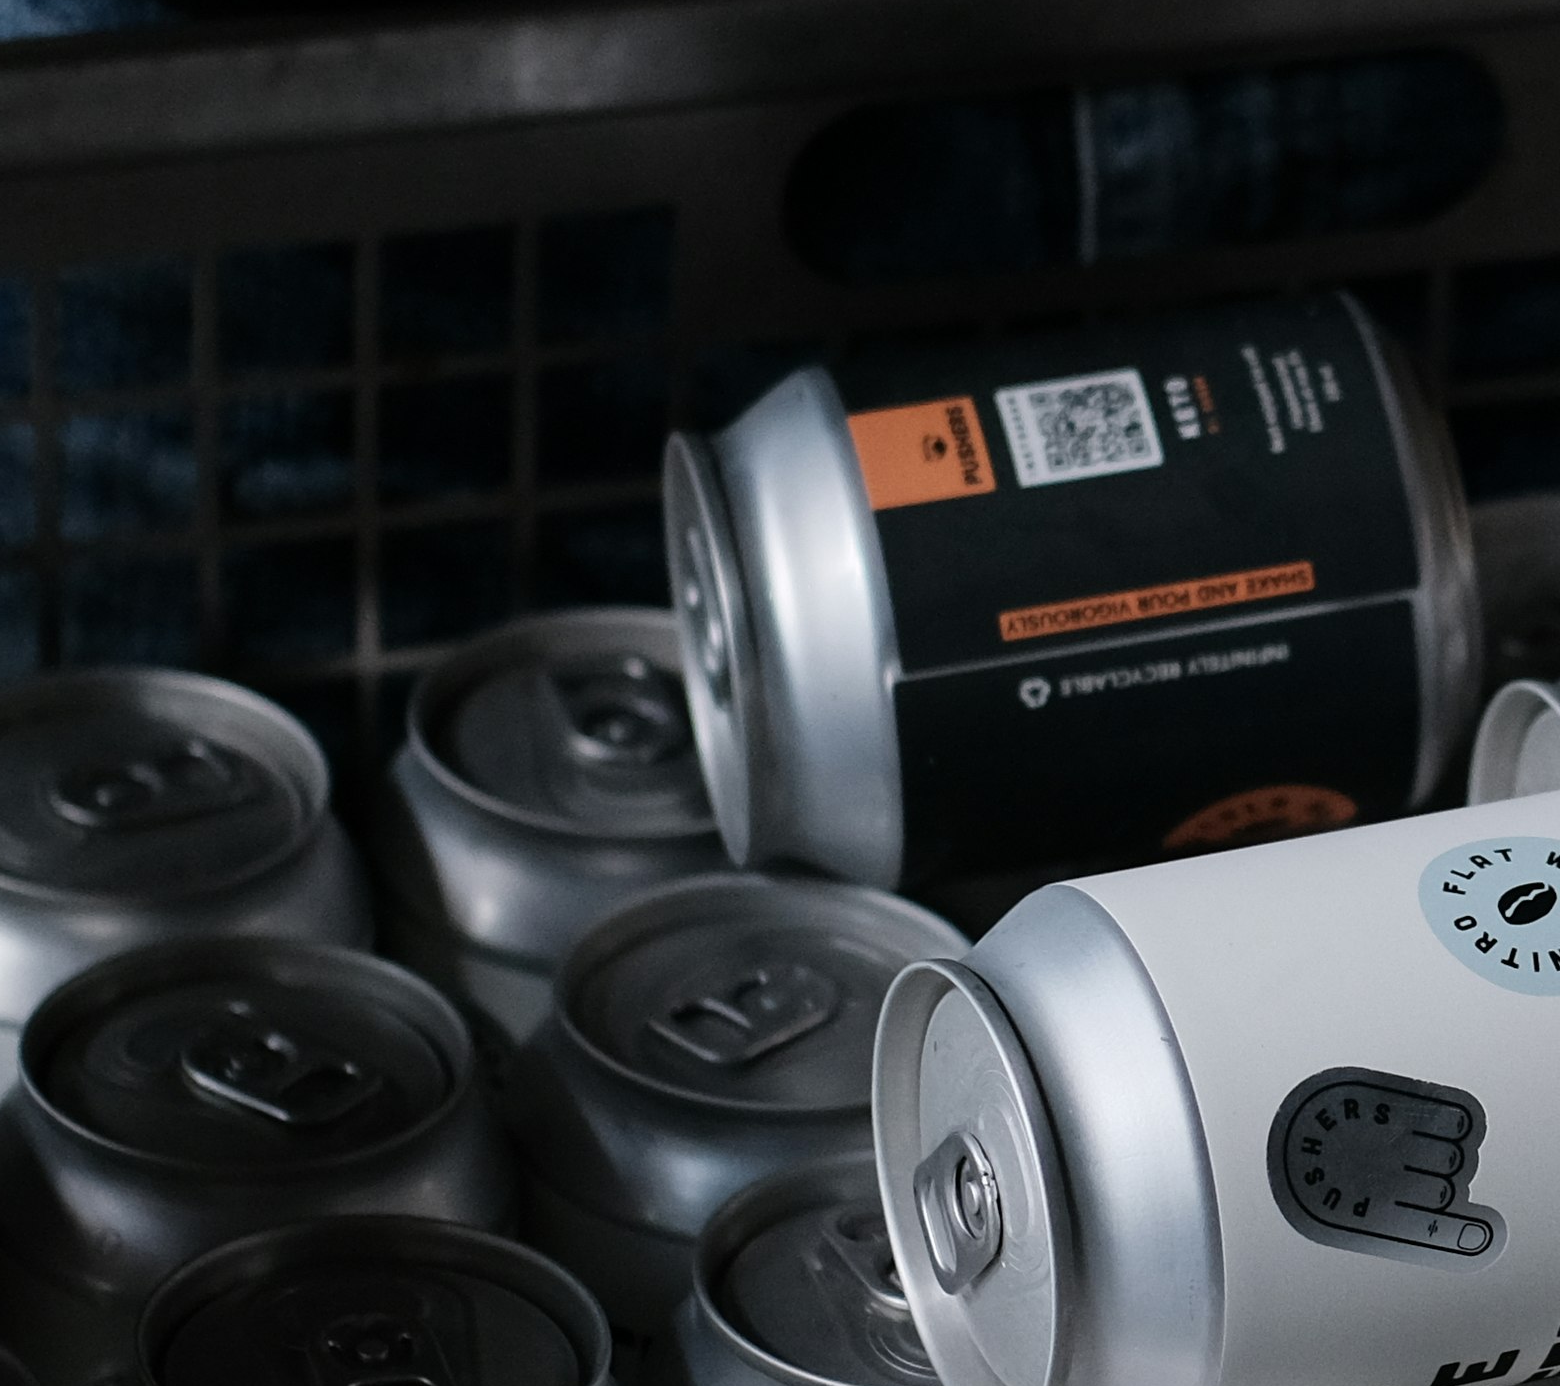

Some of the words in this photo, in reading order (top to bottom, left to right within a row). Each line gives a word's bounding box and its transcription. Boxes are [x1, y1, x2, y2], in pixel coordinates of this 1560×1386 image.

[1196, 581, 1239, 604] AND
[1244, 569, 1309, 594] SHAKE
[1006, 599, 1130, 635] VIGOROUSLY
[1137, 588, 1190, 612] POUR
[1058, 660, 1183, 699] RECYCLABLE
[1442, 848, 1513, 895] FLAT
[1301, 1098, 1391, 1218] PUSHERS
